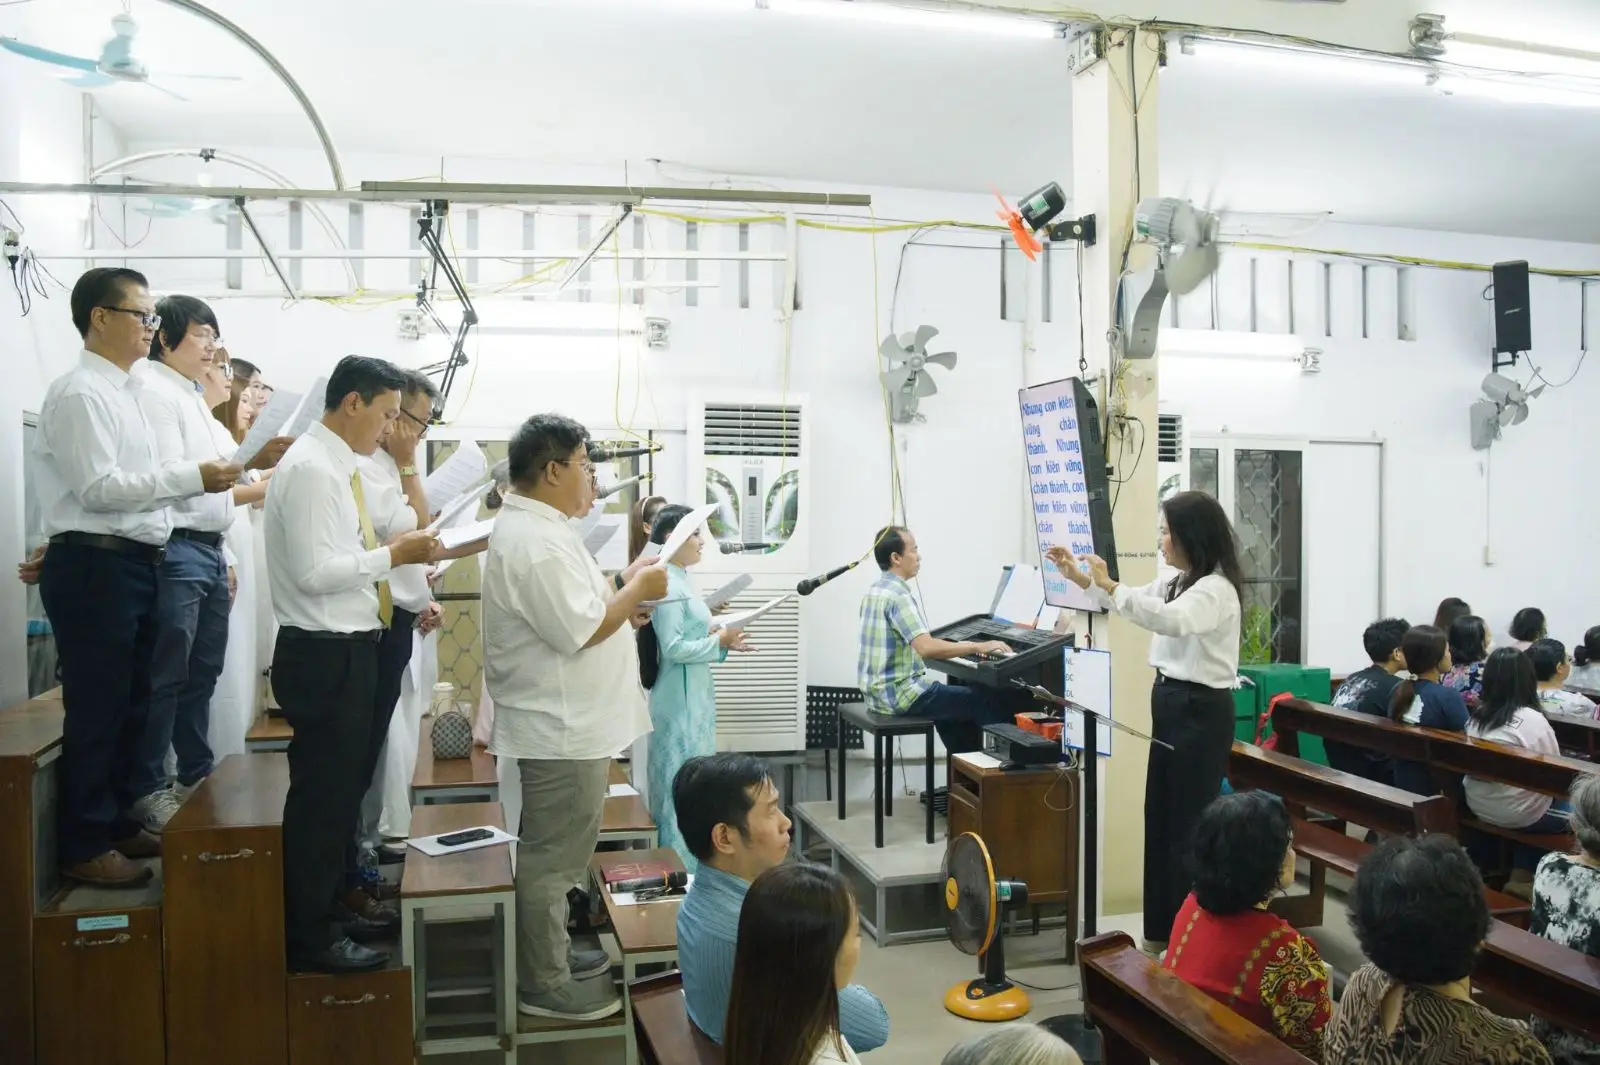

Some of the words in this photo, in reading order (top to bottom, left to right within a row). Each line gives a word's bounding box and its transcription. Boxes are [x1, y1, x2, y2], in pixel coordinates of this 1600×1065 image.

[1045, 400, 1057, 412] con
[1031, 464, 1042, 474] con
[1072, 482, 1085, 492] con
